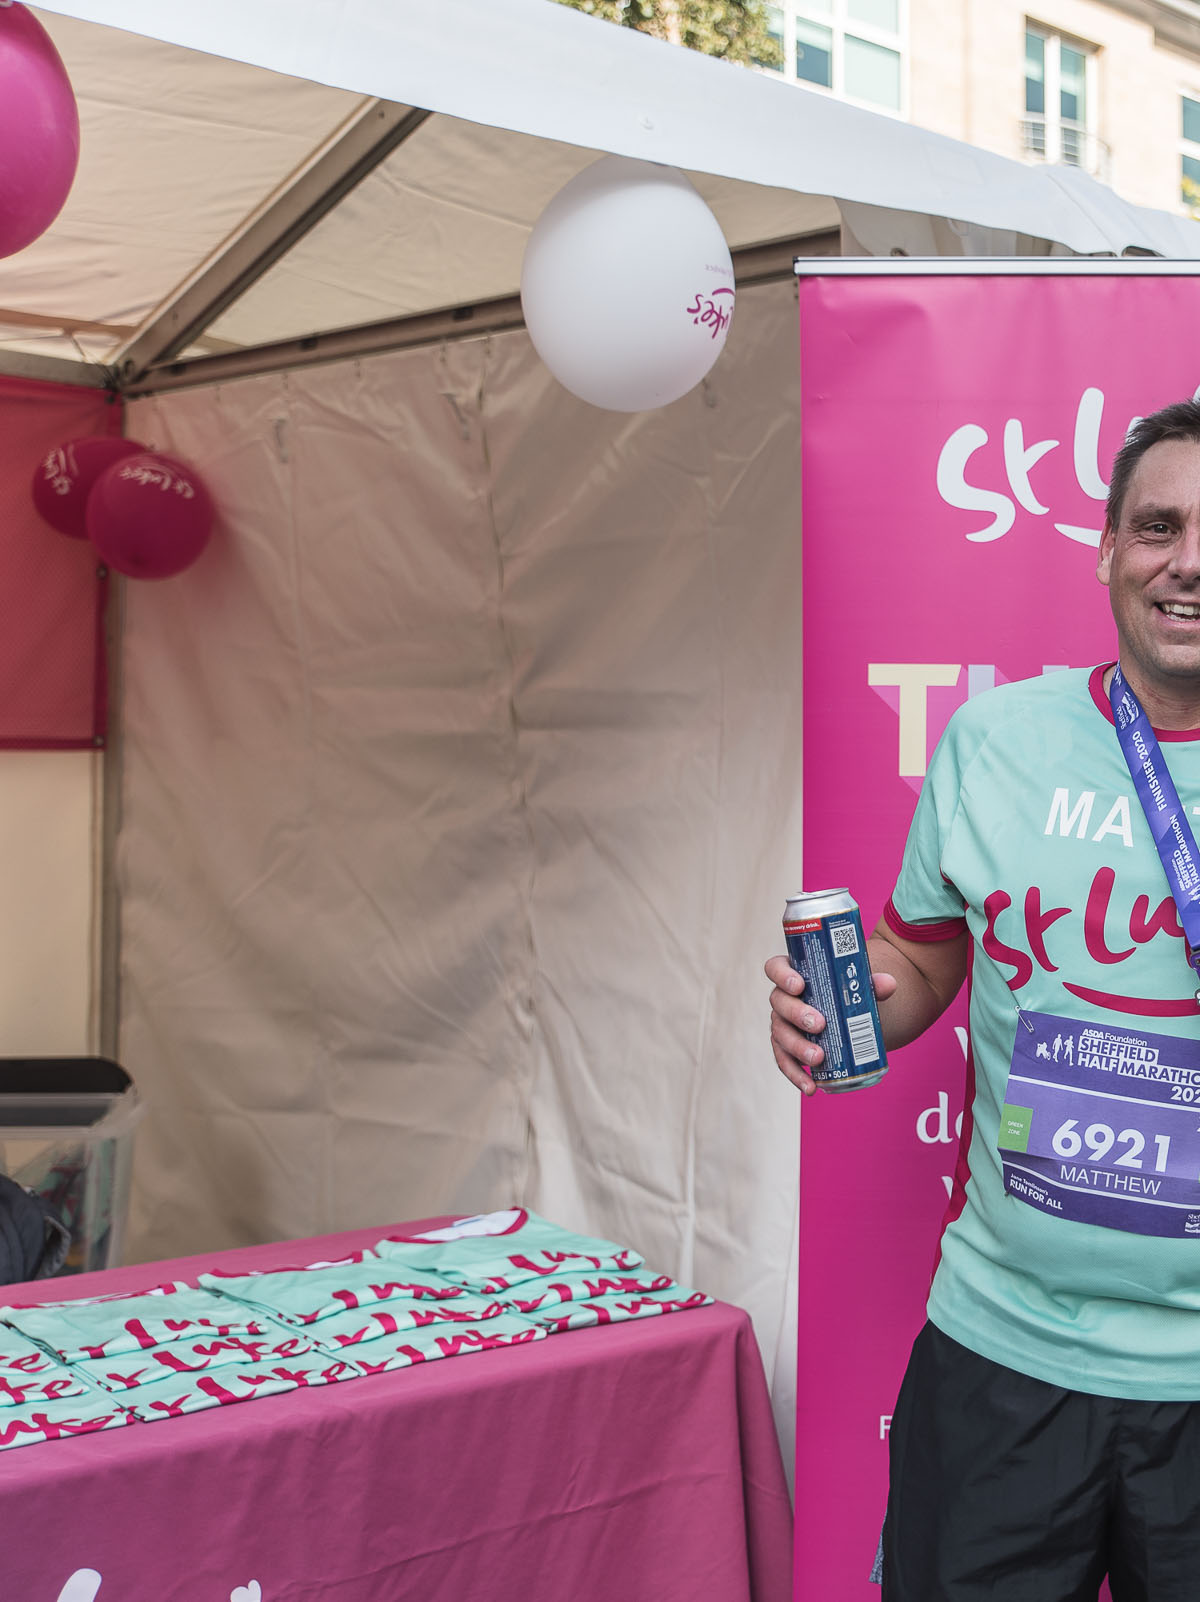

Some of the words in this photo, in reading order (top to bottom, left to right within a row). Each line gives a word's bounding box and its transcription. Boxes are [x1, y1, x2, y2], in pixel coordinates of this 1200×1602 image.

[687, 294, 734, 339] uke's
[1132, 730, 1149, 760] 2020
[1142, 757, 1167, 812] FINISHER
[1169, 814, 1192, 863] MARATHON
[1173, 849, 1193, 889] SHEFFIELD
[1187, 863, 1200, 885] HALF
[982, 886, 1072, 991] St
[1080, 1038, 1156, 1063] SHEFFIELD
[1082, 1028, 1104, 1040] ASDA
[1104, 1032, 1147, 1047] Foundation
[1077, 1052, 1119, 1073] HALF
[1007, 1120, 1024, 1128] GREEN
[1007, 1128, 1021, 1136] ZONE
[1051, 1119, 1171, 1173] 6921
[1009, 1178, 1028, 1195] RUN
[1028, 1189, 1045, 1203] FOR
[1045, 1197, 1063, 1211] ALL
[1010, 1173, 1022, 1182] Jane
[1023, 1178, 1049, 1195] Tomlinson's
[1060, 1164, 1162, 1196] MATTHEW
